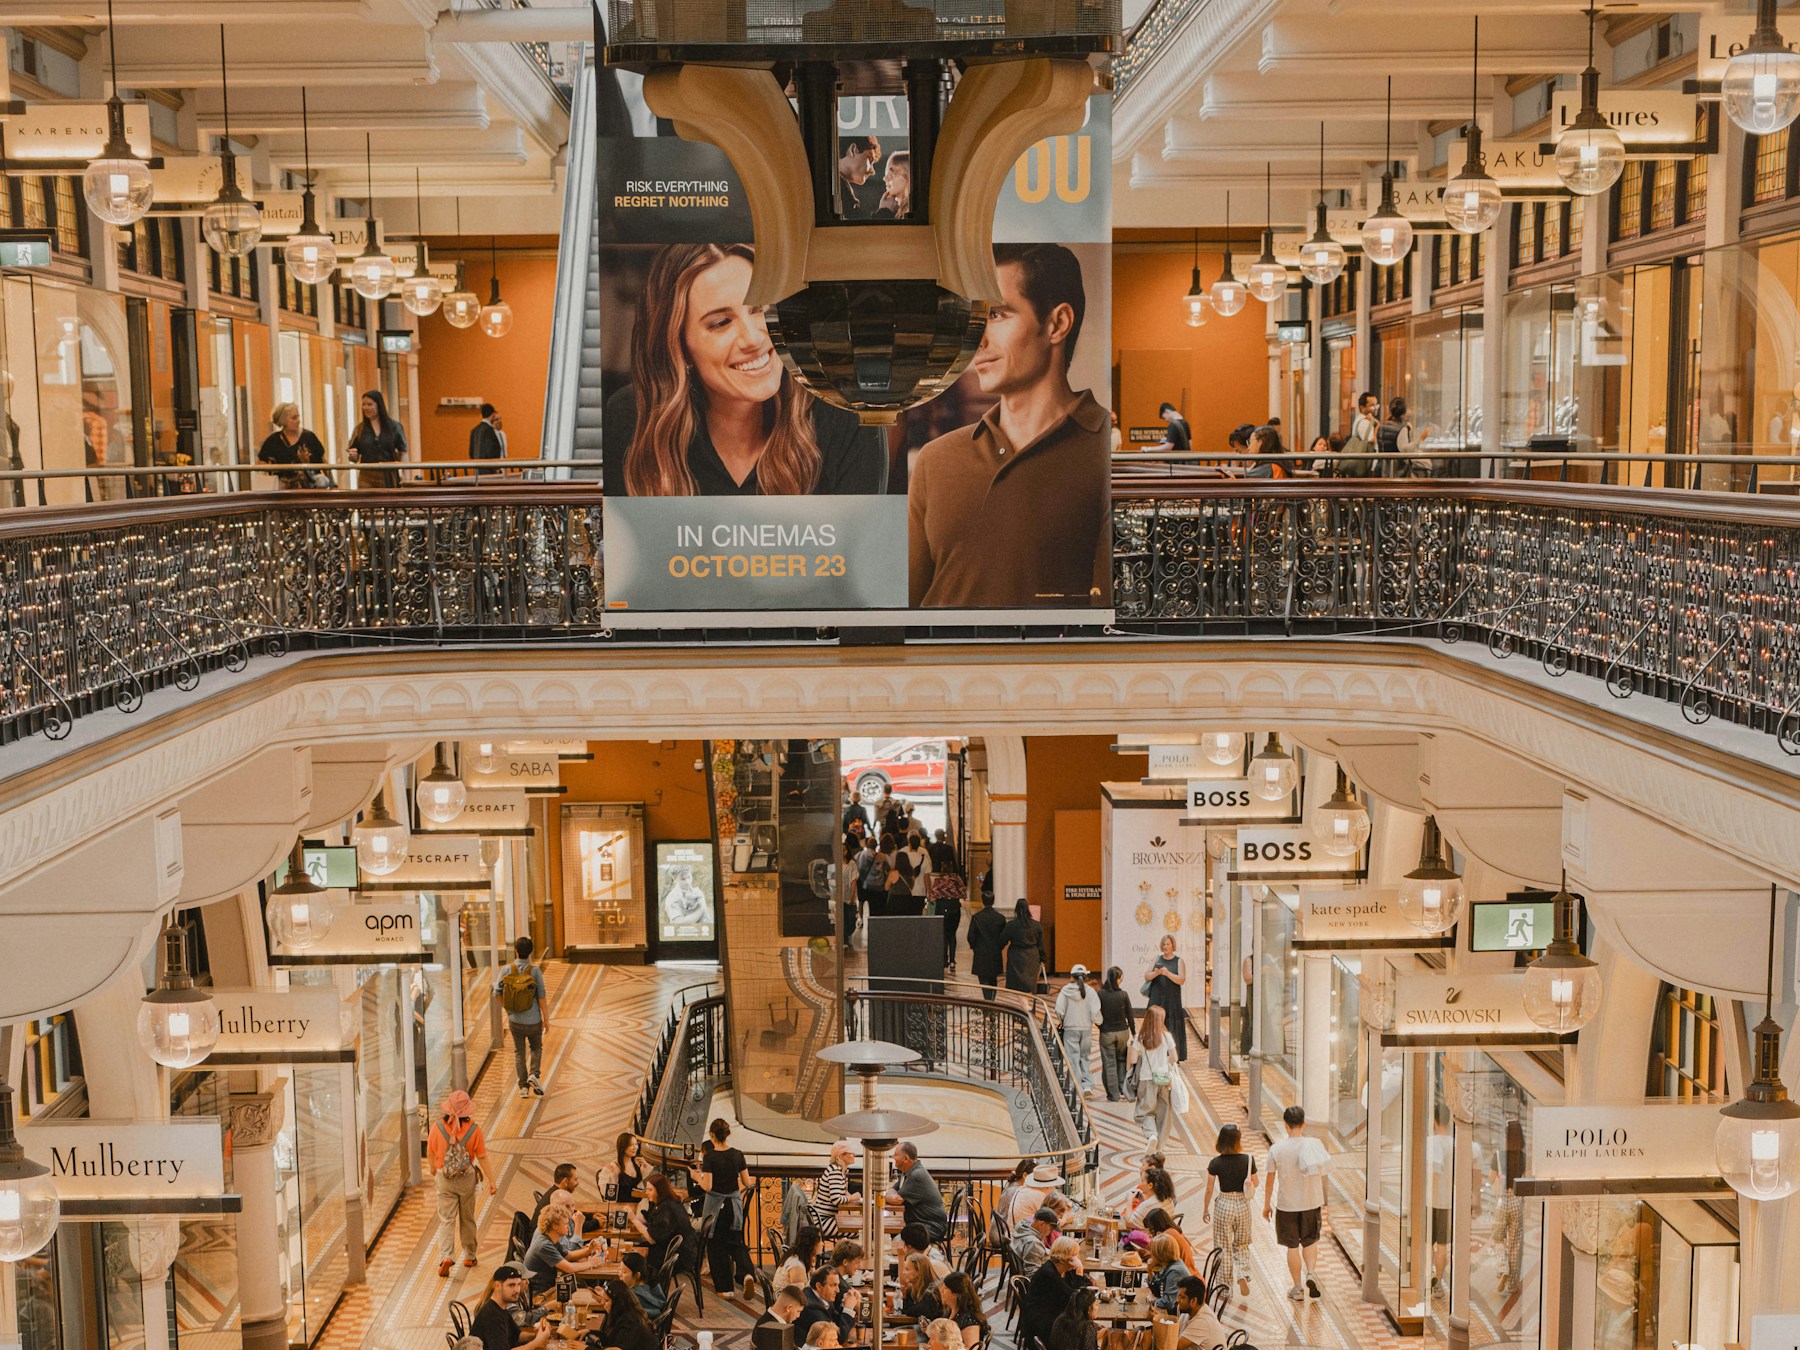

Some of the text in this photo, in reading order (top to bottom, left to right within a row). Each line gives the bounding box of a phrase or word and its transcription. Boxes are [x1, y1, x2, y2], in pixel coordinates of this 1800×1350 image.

[1561, 105, 1659, 126] Lsures
[18, 127, 133, 135] KARENGE
[1015, 136, 1091, 203] OU
[626, 181, 729, 192] RISK EVERYTHING
[614, 195, 729, 207] REGRET NOTHING
[1393, 190, 1434, 205] BAK
[677, 524, 836, 547] IN CINEMAS
[668, 554, 846, 577] OCTOBER 23
[1162, 755, 1189, 763] POLO
[510, 762, 554, 776] SABA
[1194, 791, 1250, 807] BOSS
[404, 854, 469, 863] TSCRAFT
[1132, 852, 1185, 865] BROWNS
[1244, 842, 1312, 861] BOSS
[1311, 902, 1387, 919] kate spade
[365, 914, 413, 935] apm
[1406, 1009, 1501, 1024] SWAROVSKI
[1565, 1128, 1628, 1146] POLO
[1546, 1148, 1645, 1158] RALPH LAUREN
[50, 1142, 185, 1184] Mulberry
